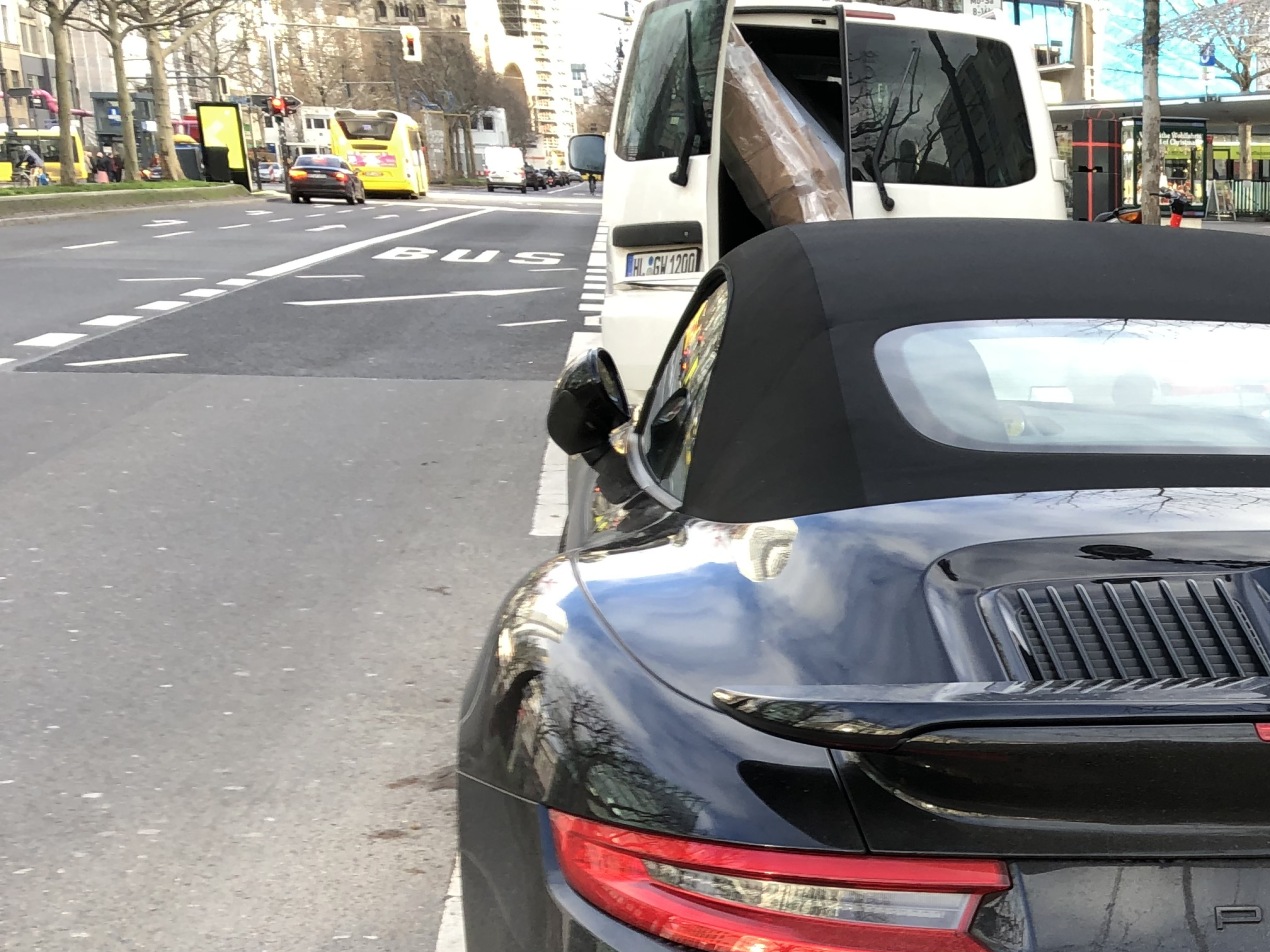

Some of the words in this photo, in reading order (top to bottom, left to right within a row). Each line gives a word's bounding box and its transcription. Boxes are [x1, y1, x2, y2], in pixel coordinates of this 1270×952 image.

[371, 246, 566, 265] BUS
[653, 255, 668, 275] GW
[670, 252, 695, 274] 1200
